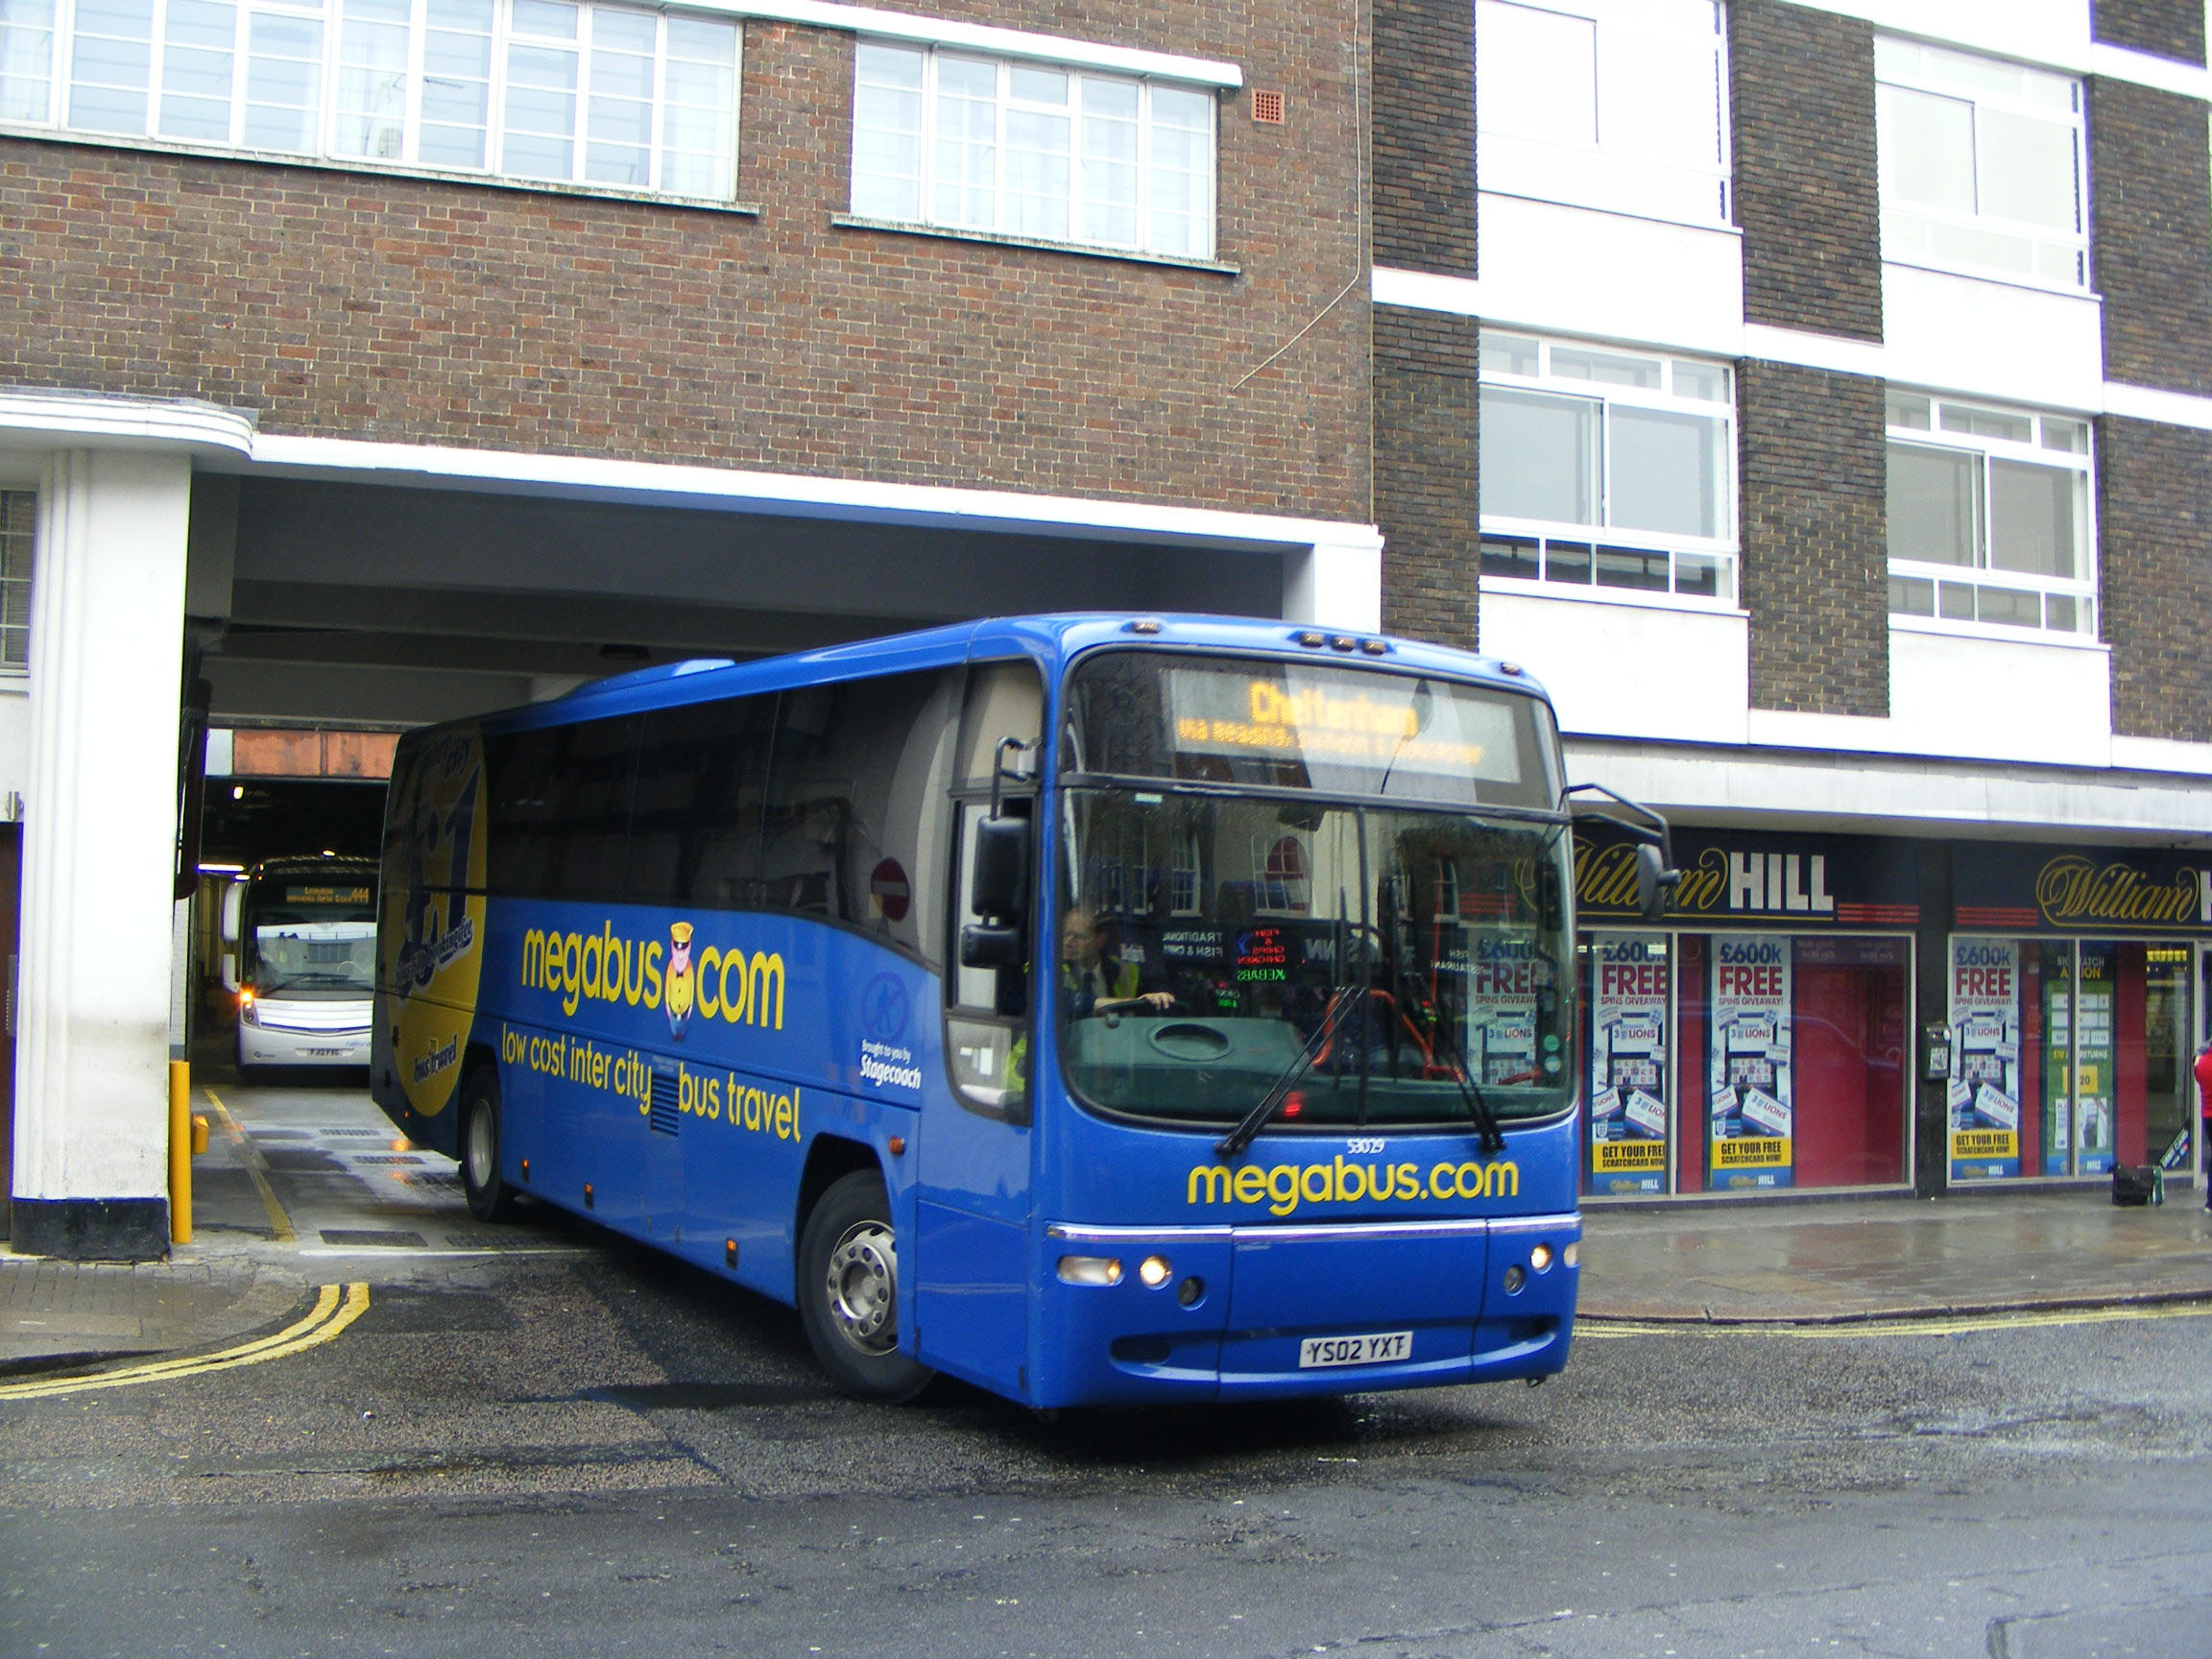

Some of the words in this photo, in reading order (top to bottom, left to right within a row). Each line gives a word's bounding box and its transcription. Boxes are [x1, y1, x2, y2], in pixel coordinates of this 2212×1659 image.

[1729, 851, 1834, 911] HILL
[2036, 854, 2200, 925] William
[1719, 943, 1783, 963] £600k
[1957, 946, 2010, 966] £600k
[1602, 964, 1667, 996] FREE
[1719, 966, 1783, 996] FREE
[1956, 968, 2011, 996] FREE
[1614, 1029, 1620, 1039] 3
[1628, 1028, 1656, 1038] LIONS
[1731, 1029, 1736, 1038] 3
[1745, 1028, 1770, 1038] LIONS
[1978, 1027, 2000, 1037] LIONS
[902, 1047, 911, 1065] by
[860, 1054, 922, 1090] Stagecoach
[502, 1022, 526, 1065] low
[530, 1034, 565, 1077] cost
[570, 1037, 612, 1090] inter
[613, 1050, 652, 1117] city
[679, 1061, 720, 1119] bus
[727, 1071, 801, 1143] travel
[1764, 1102, 1787, 1119] LIONS
[1347, 1138, 1385, 1154] 53029
[1720, 1142, 1736, 1155] GET
[1738, 1142, 1761, 1154] YOUR
[1763, 1142, 1781, 1153] FREE
[1957, 1135, 1970, 1145] GET
[1971, 1135, 1991, 1144] YOUR
[1993, 1134, 2009, 1144] FREE
[1602, 1145, 1619, 1158] GET
[1621, 1145, 1646, 1158] YOUR
[1647, 1145, 1665, 1157] FRE
[1602, 1158, 1648, 1167] SCRATCHCARD
[1187, 1155, 1520, 1216] megabus.com
[1758, 1174, 1774, 1186] HILL
[1310, 1339, 1362, 1363] YS02
[1368, 1335, 1405, 1358] YXT
